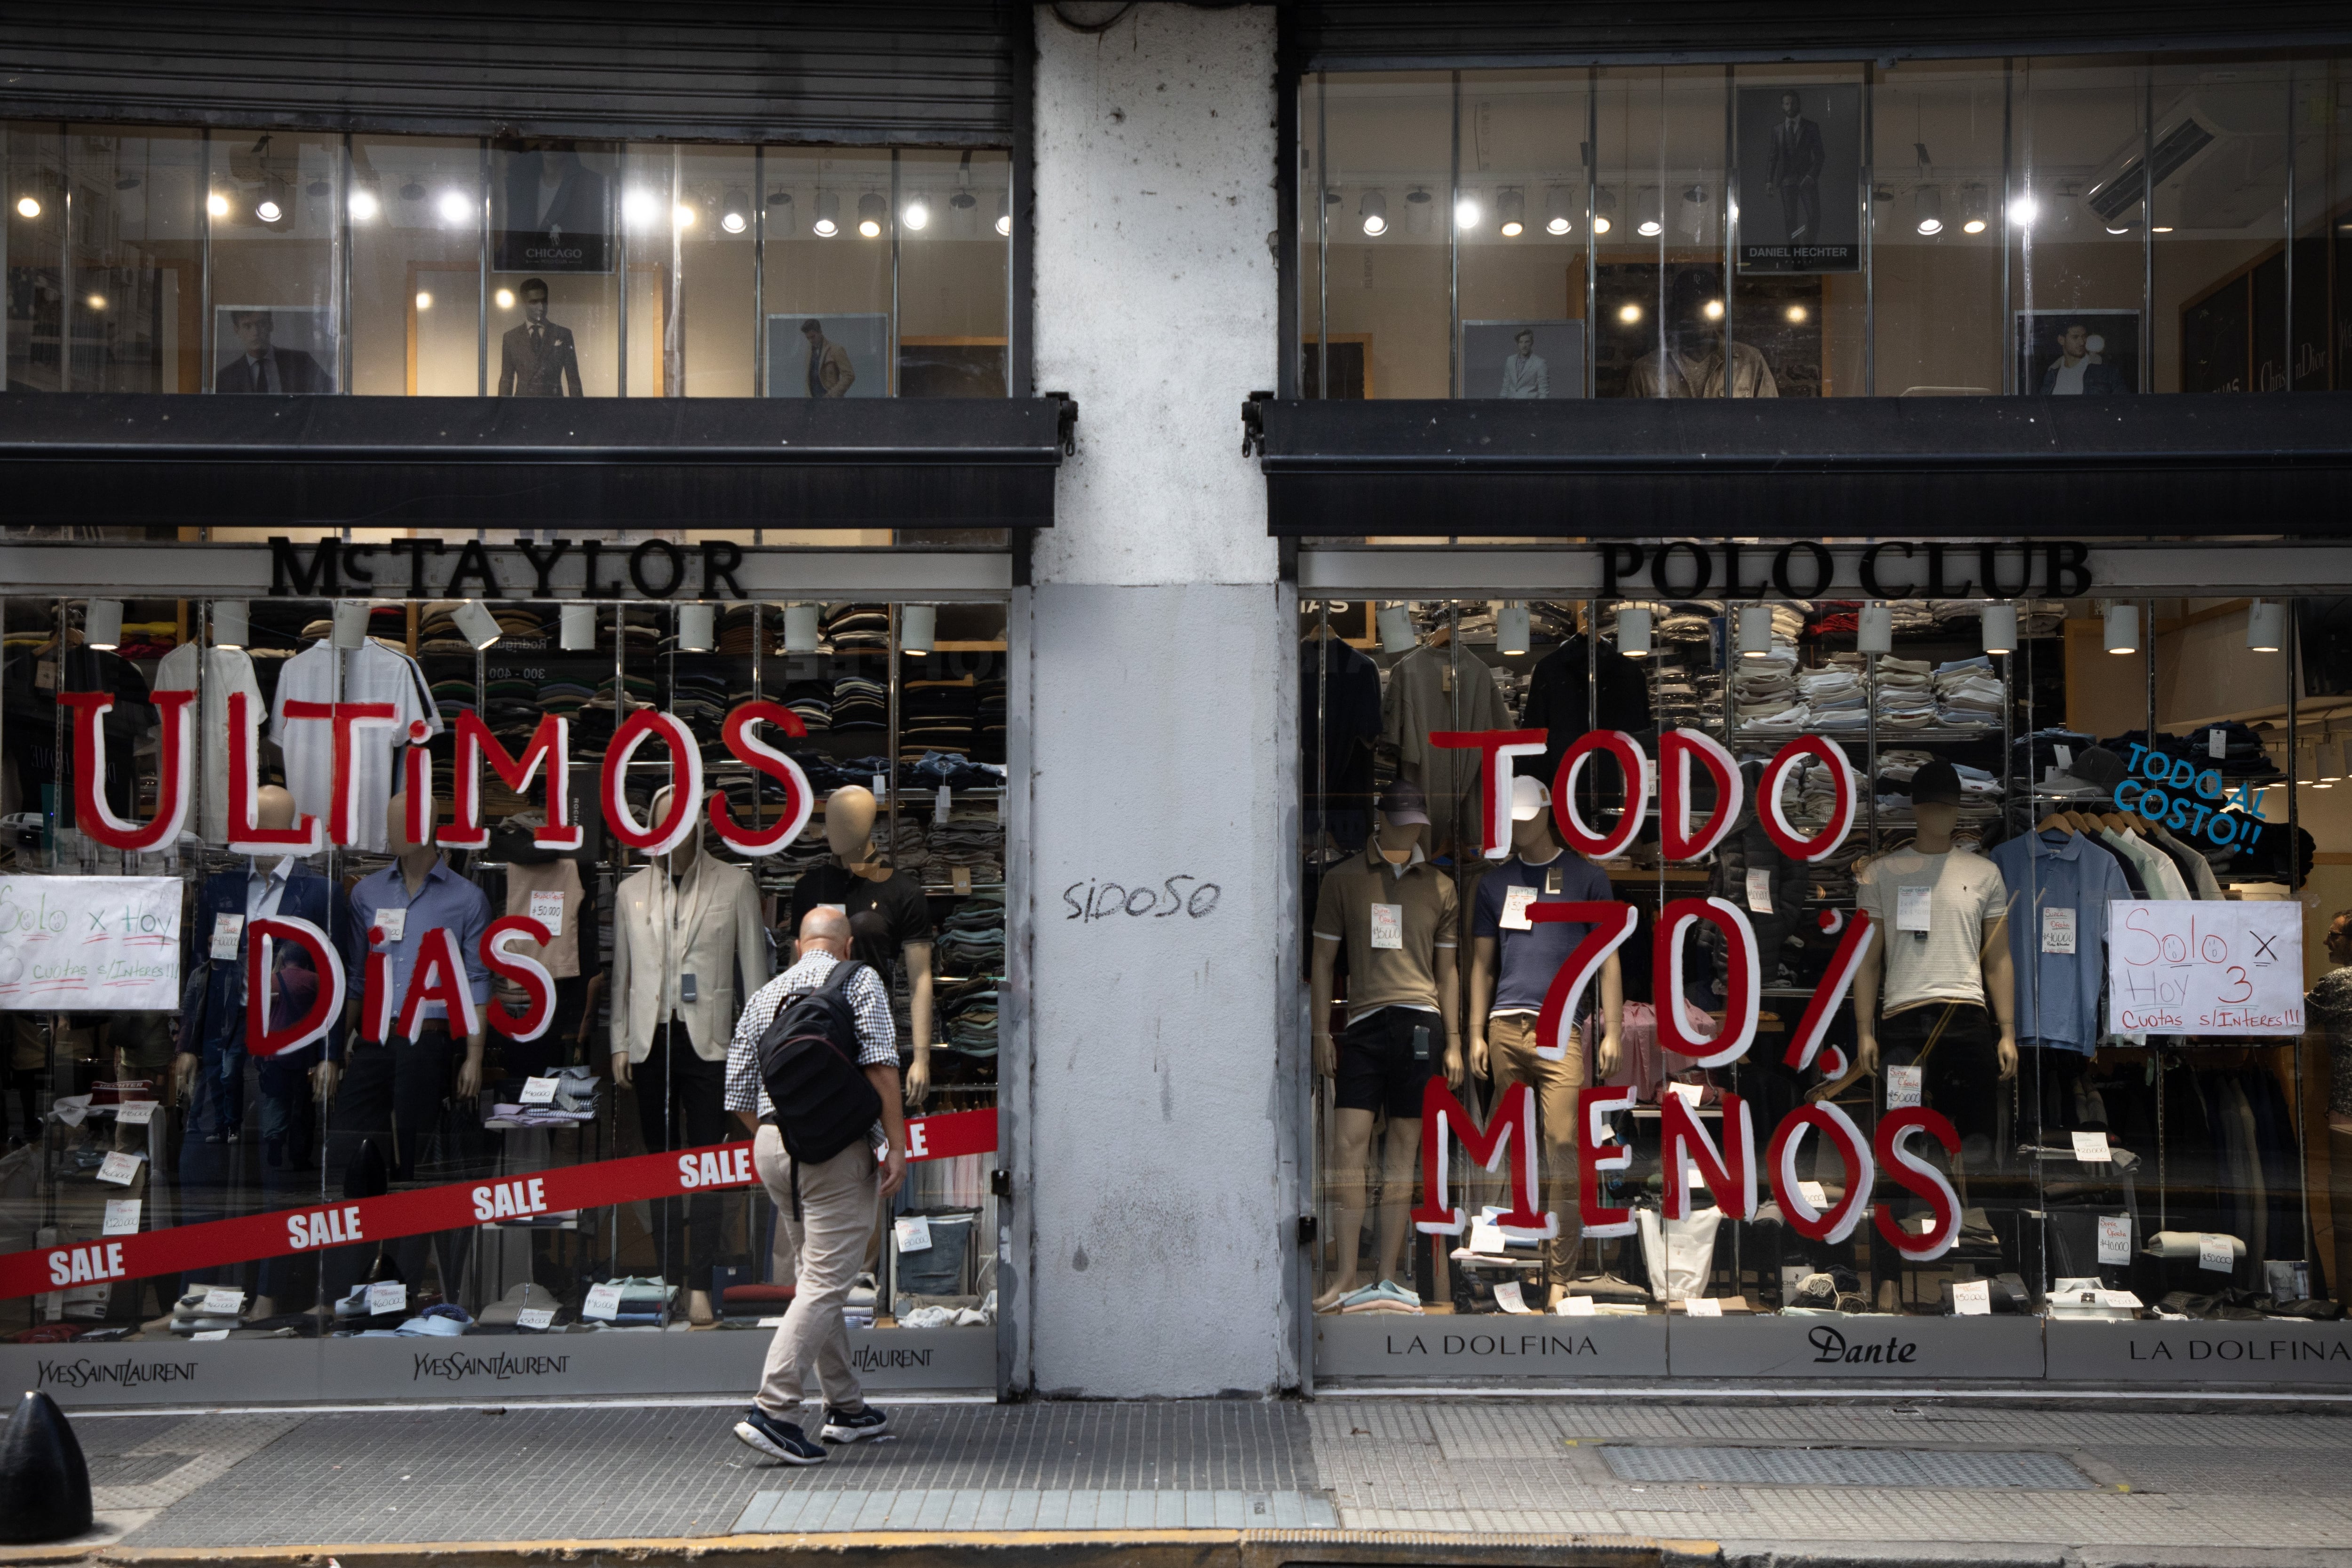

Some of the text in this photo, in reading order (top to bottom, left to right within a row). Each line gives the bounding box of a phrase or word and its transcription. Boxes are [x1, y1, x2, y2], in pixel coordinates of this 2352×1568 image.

[526, 248, 582, 258] CHICAGO
[1749, 247, 1847, 257] DANIEL HECHTER
[1597, 541, 2092, 600] POLO CLUB
[1429, 727, 1857, 863] TODO
[2128, 742, 2223, 800] TODO
[2225, 782, 2267, 819] AL
[2114, 779, 2263, 855] COSTO!!
[0, 885, 67, 934] Solo
[121, 902, 173, 951] Hoy
[2124, 908, 2227, 966] Solo
[1525, 896, 1876, 1081] 70%
[2217, 966, 2252, 1003] 3
[679, 1148, 752, 1189] SALE
[1410, 1074, 1963, 1261] MENOS
[472, 1177, 547, 1221] SALE
[286, 1206, 364, 1250] SALE
[48, 1242, 126, 1286] SALE
[1387, 1335, 1598, 1355] LA DOLFINA
[1808, 1325, 1917, 1363] Dante
[2130, 1340, 2352, 1360] LA DOLFINA
